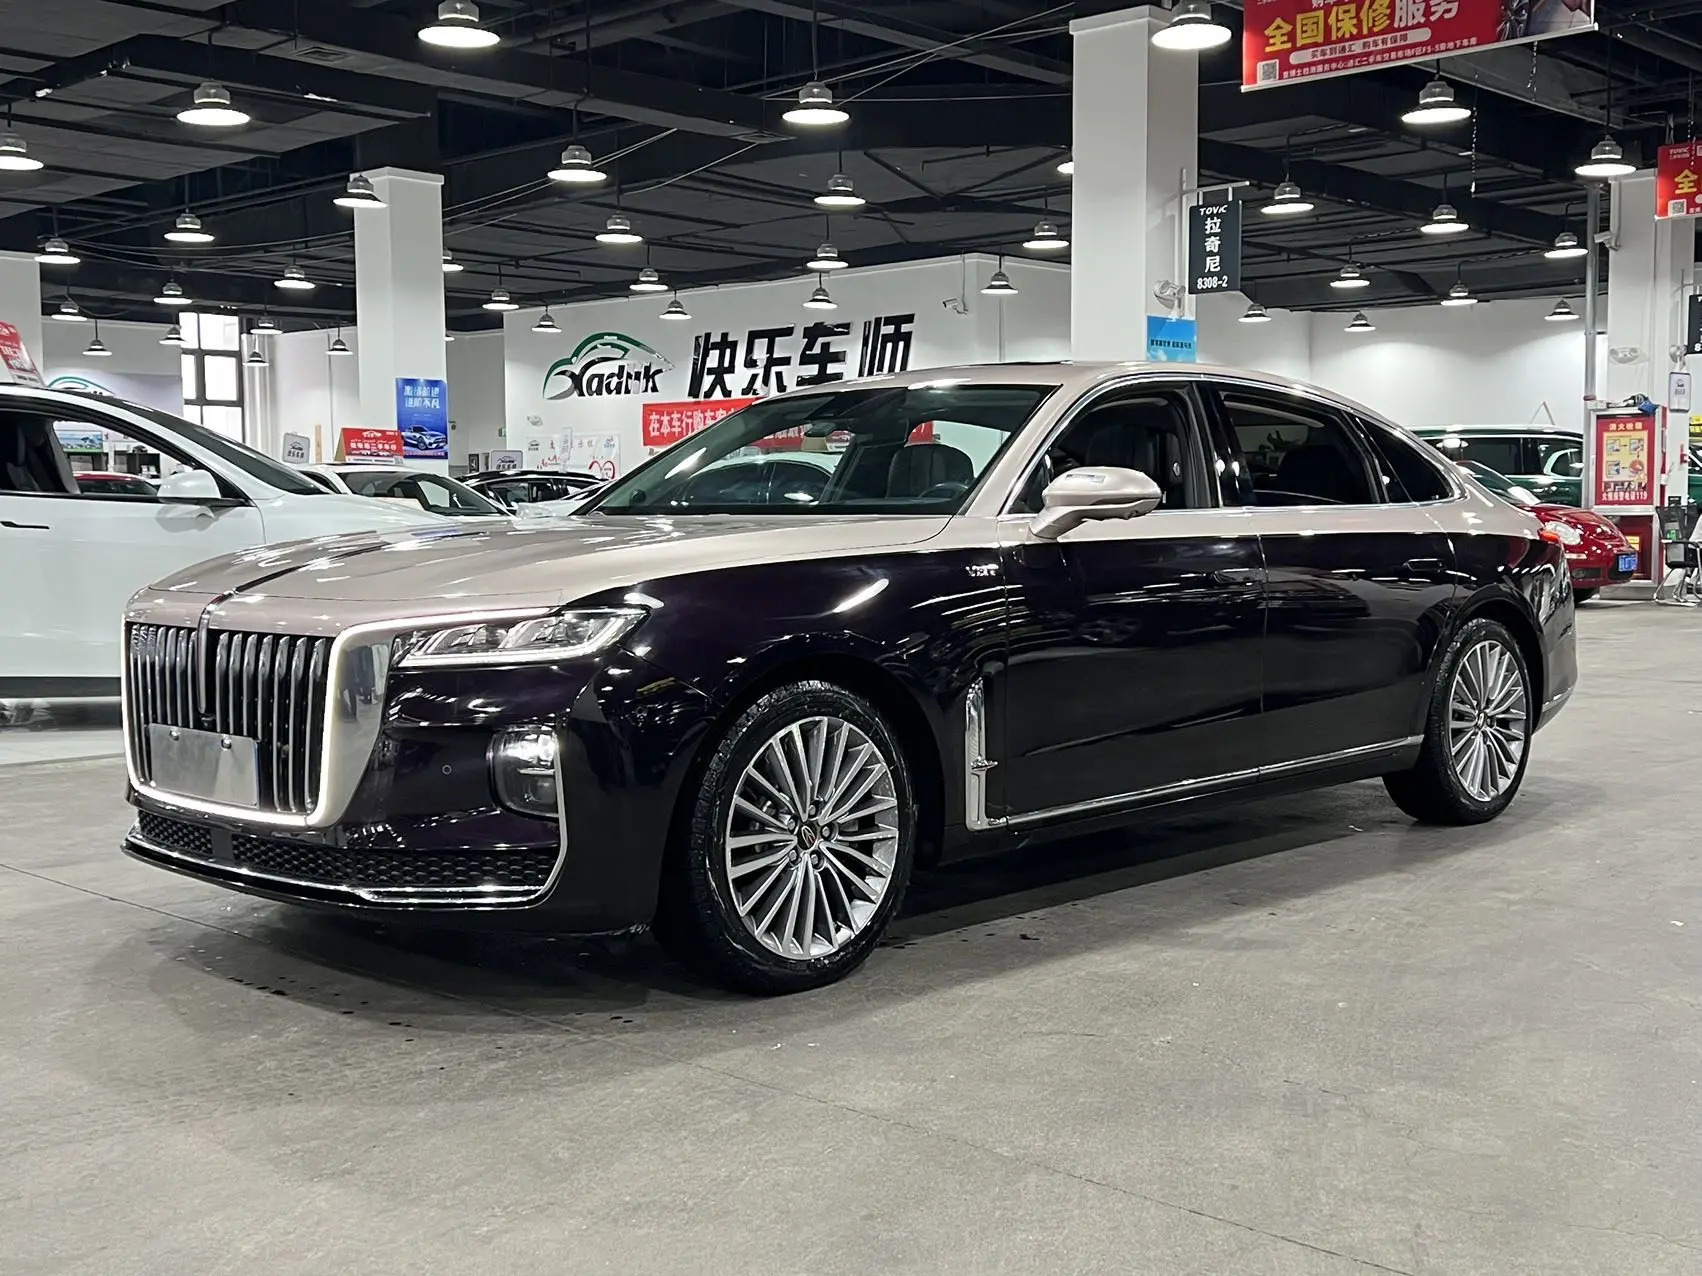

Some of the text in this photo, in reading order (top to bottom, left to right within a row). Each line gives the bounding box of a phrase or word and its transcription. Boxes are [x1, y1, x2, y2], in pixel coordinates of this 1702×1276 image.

[1264, 0, 1460, 52] 全国保修服务
[1674, 169, 1699, 194] 全
[1200, 205, 1228, 215] TOVIC
[1205, 217, 1221, 273] 拉奇尼
[1197, 275, 1228, 289] 8308-2
[688, 313, 915, 399] 快乐车师
[649, 407, 735, 437] 在本车行购车
